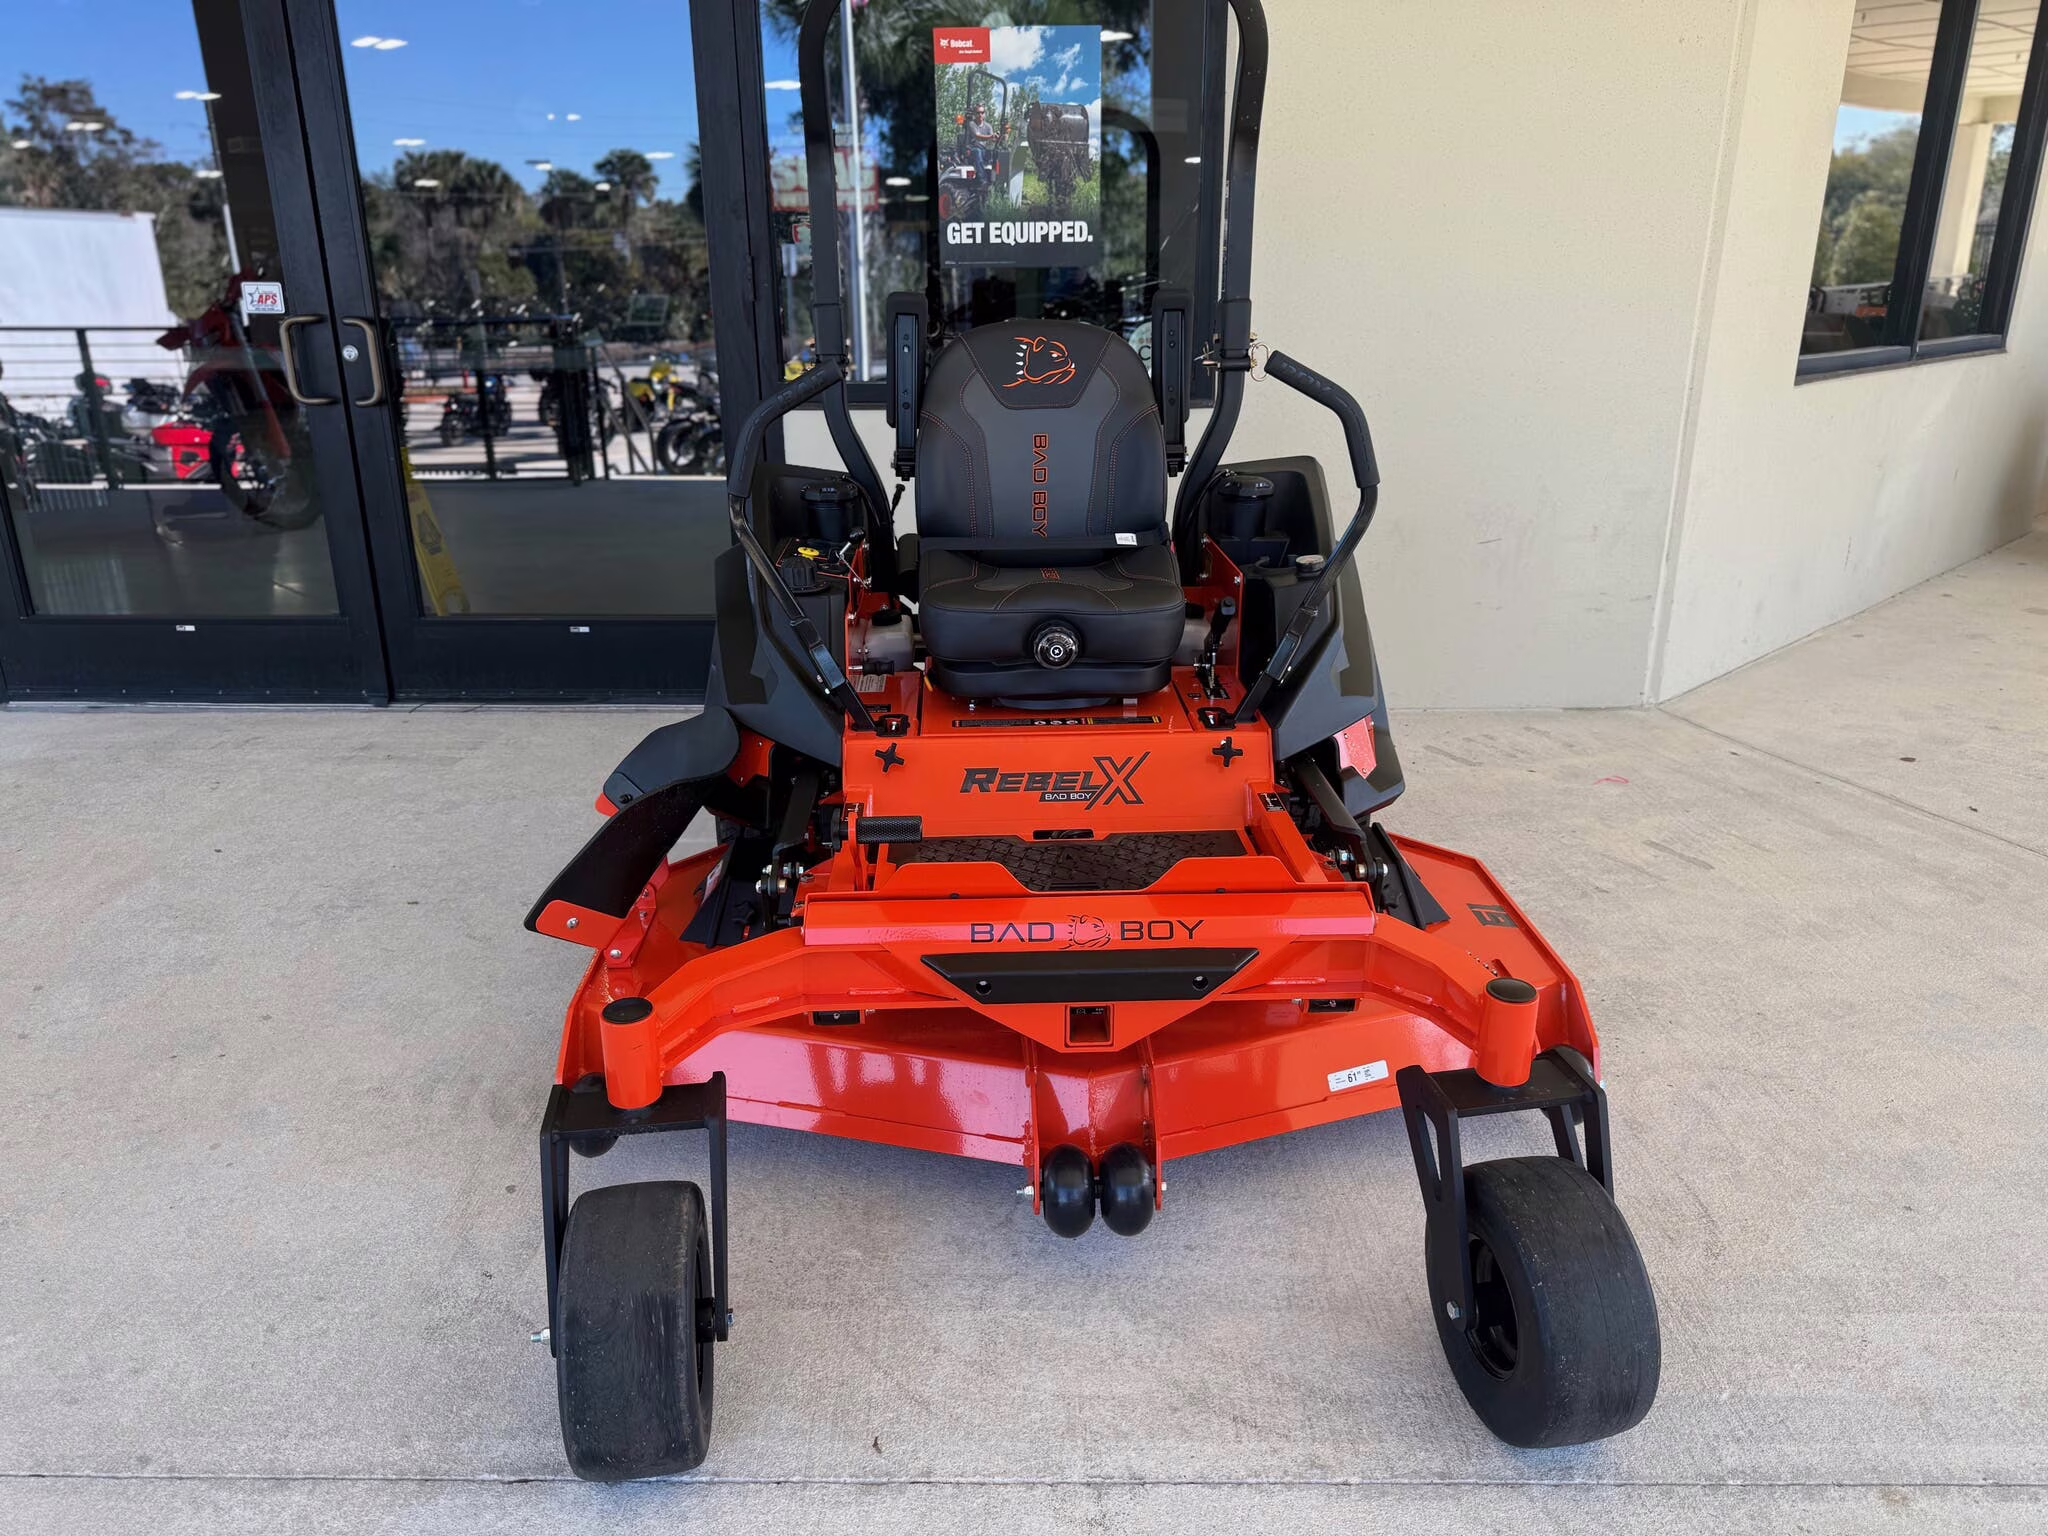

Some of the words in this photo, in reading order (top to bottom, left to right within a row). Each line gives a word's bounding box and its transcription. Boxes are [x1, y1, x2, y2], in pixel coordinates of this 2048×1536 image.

[946, 222, 985, 245] GET
[989, 221, 1094, 247] EQUIPPED.
[257, 294, 277, 304] APS
[1033, 433, 1048, 484] BAD
[1032, 490, 1047, 537] BOY
[1070, 792, 1092, 800] BOY
[970, 922, 1055, 943] BAD
[1120, 919, 1205, 941] BOY
